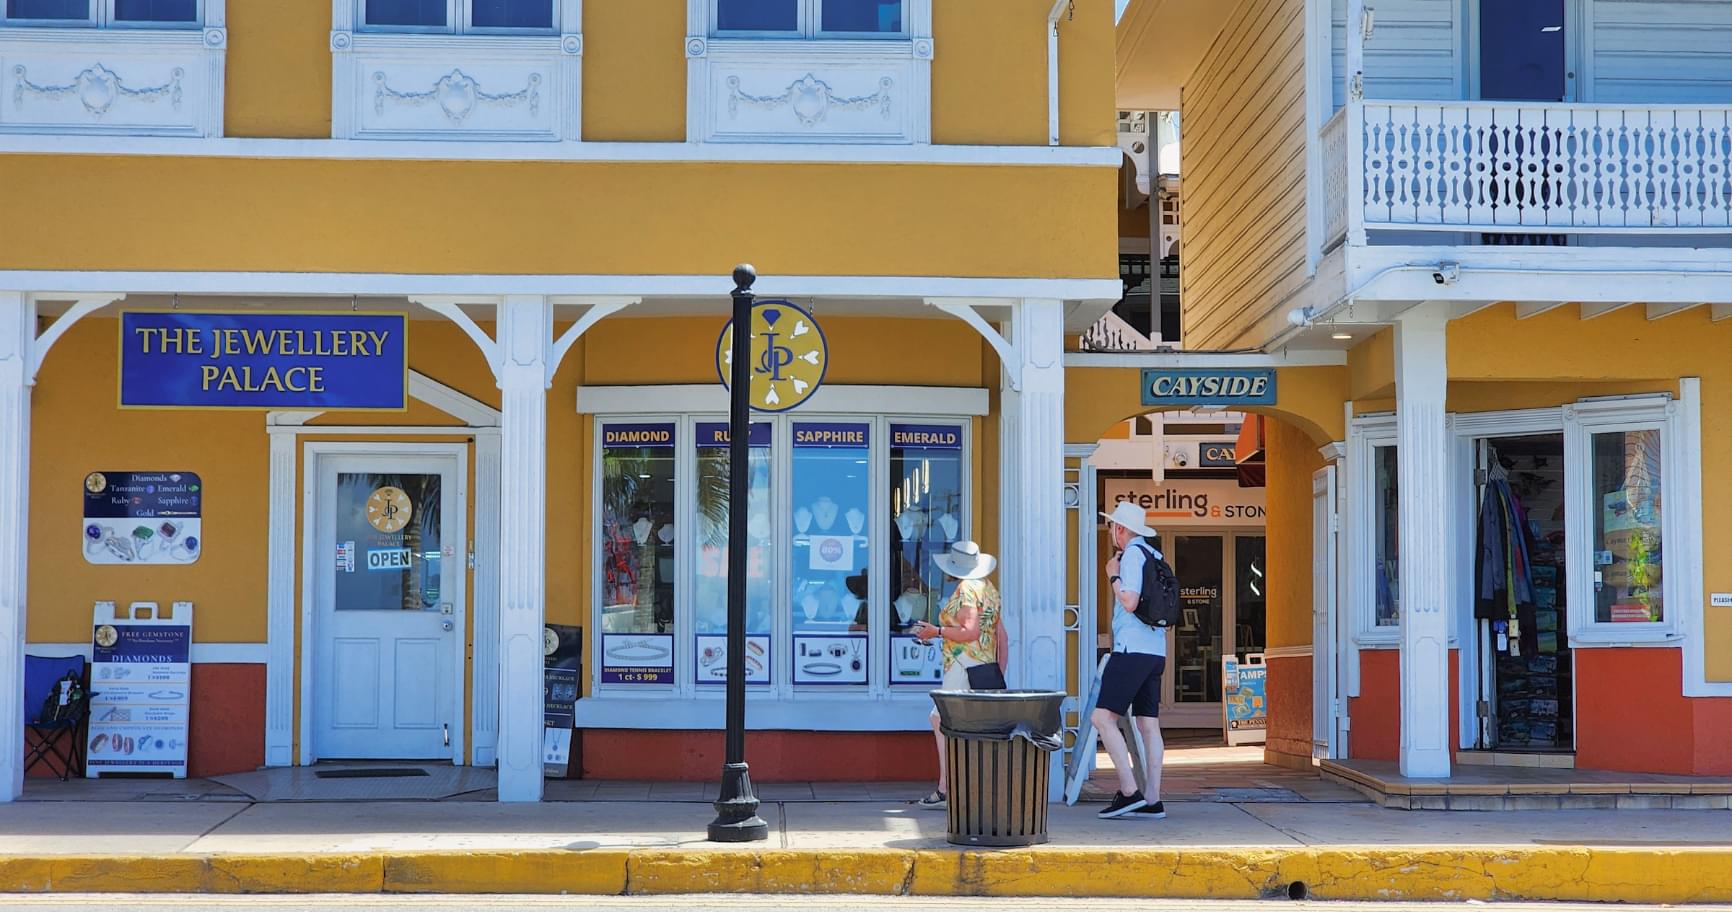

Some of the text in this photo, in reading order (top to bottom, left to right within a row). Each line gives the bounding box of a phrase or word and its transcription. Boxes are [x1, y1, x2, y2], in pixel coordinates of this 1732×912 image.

[136, 328, 389, 358] THE JEWELLERY
[200, 366, 325, 392] PALACE
[1152, 376, 1269, 397] CAYSIDE
[606, 430, 670, 442] DIAMOND
[714, 430, 752, 442] RU
[796, 430, 864, 443] SAPPHIRE
[894, 431, 956, 444] EMERALD
[131, 474, 167, 482] Diamonds
[110, 485, 146, 493] Tanzanite
[158, 484, 187, 493] Emerald
[112, 496, 130, 506] Ruby
[158, 497, 189, 507] Sapphire
[1114, 489, 1208, 517] sterling
[1210, 505, 1221, 517] &
[136, 509, 154, 517] Gold
[369, 551, 410, 567] OPEN
[1180, 586, 1217, 598] sterling
[112, 655, 173, 663] DIAMONDS
[643, 673, 658, 681] 999
